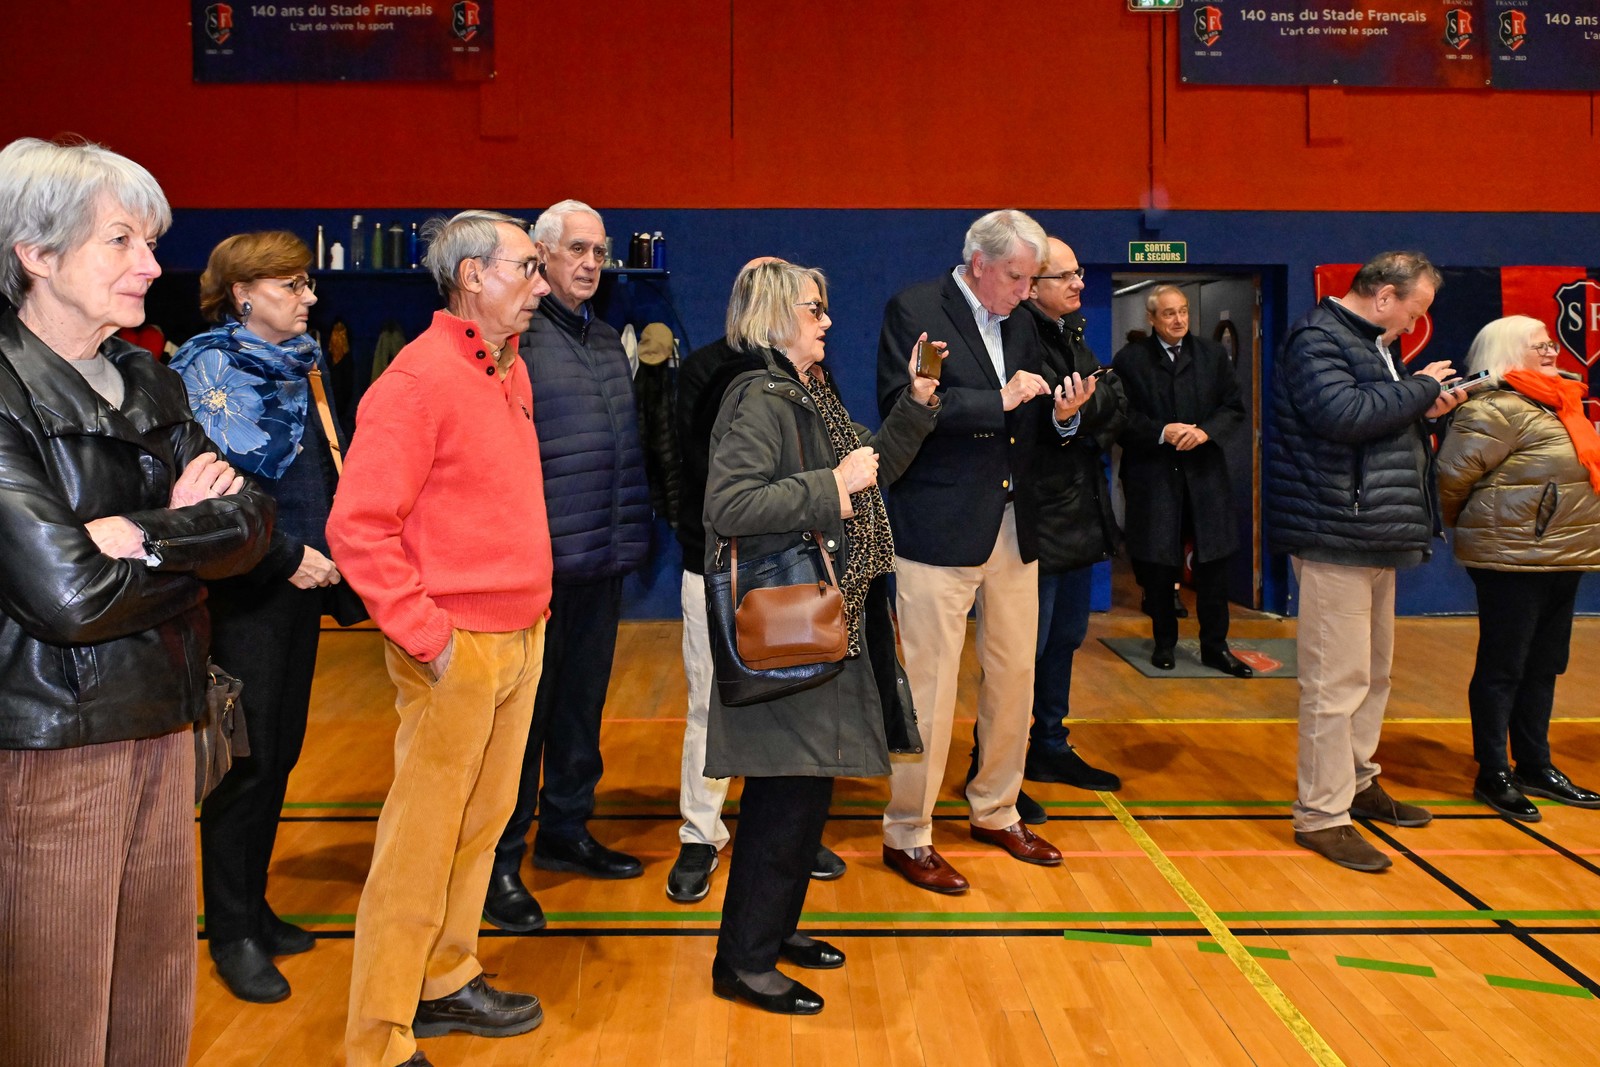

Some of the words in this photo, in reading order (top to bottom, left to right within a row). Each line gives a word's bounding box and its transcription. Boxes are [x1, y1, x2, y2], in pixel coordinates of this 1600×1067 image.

[251, 5, 276, 17] 140
[280, 7, 304, 17] ans
[308, 5, 326, 16] du
[330, 4, 370, 16] Stade
[375, 3, 433, 17] Français
[1240, 9, 1266, 21] 140
[1270, 12, 1294, 22] ans
[1299, 9, 1318, 21] du
[1322, 9, 1364, 21] Stade
[1368, 9, 1427, 24] Français
[1545, 13, 1571, 25] 140
[1574, 16, 1598, 26] ans
[290, 22, 312, 31] L'art
[315, 22, 328, 31] de
[330, 22, 354, 31] vivre
[357, 21, 366, 30] le
[368, 22, 394, 32] sport
[1280, 27, 1304, 36] L'art
[1307, 26, 1320, 35] de
[1323, 26, 1347, 35] vivre
[1350, 26, 1359, 35] le
[1361, 27, 1388, 36] sport
[1584, 31, 1600, 40] L'a
[1144, 243, 1171, 252] SORTIE
[1135, 252, 1145, 261] DE
[1146, 252, 1181, 261] SECOURS
